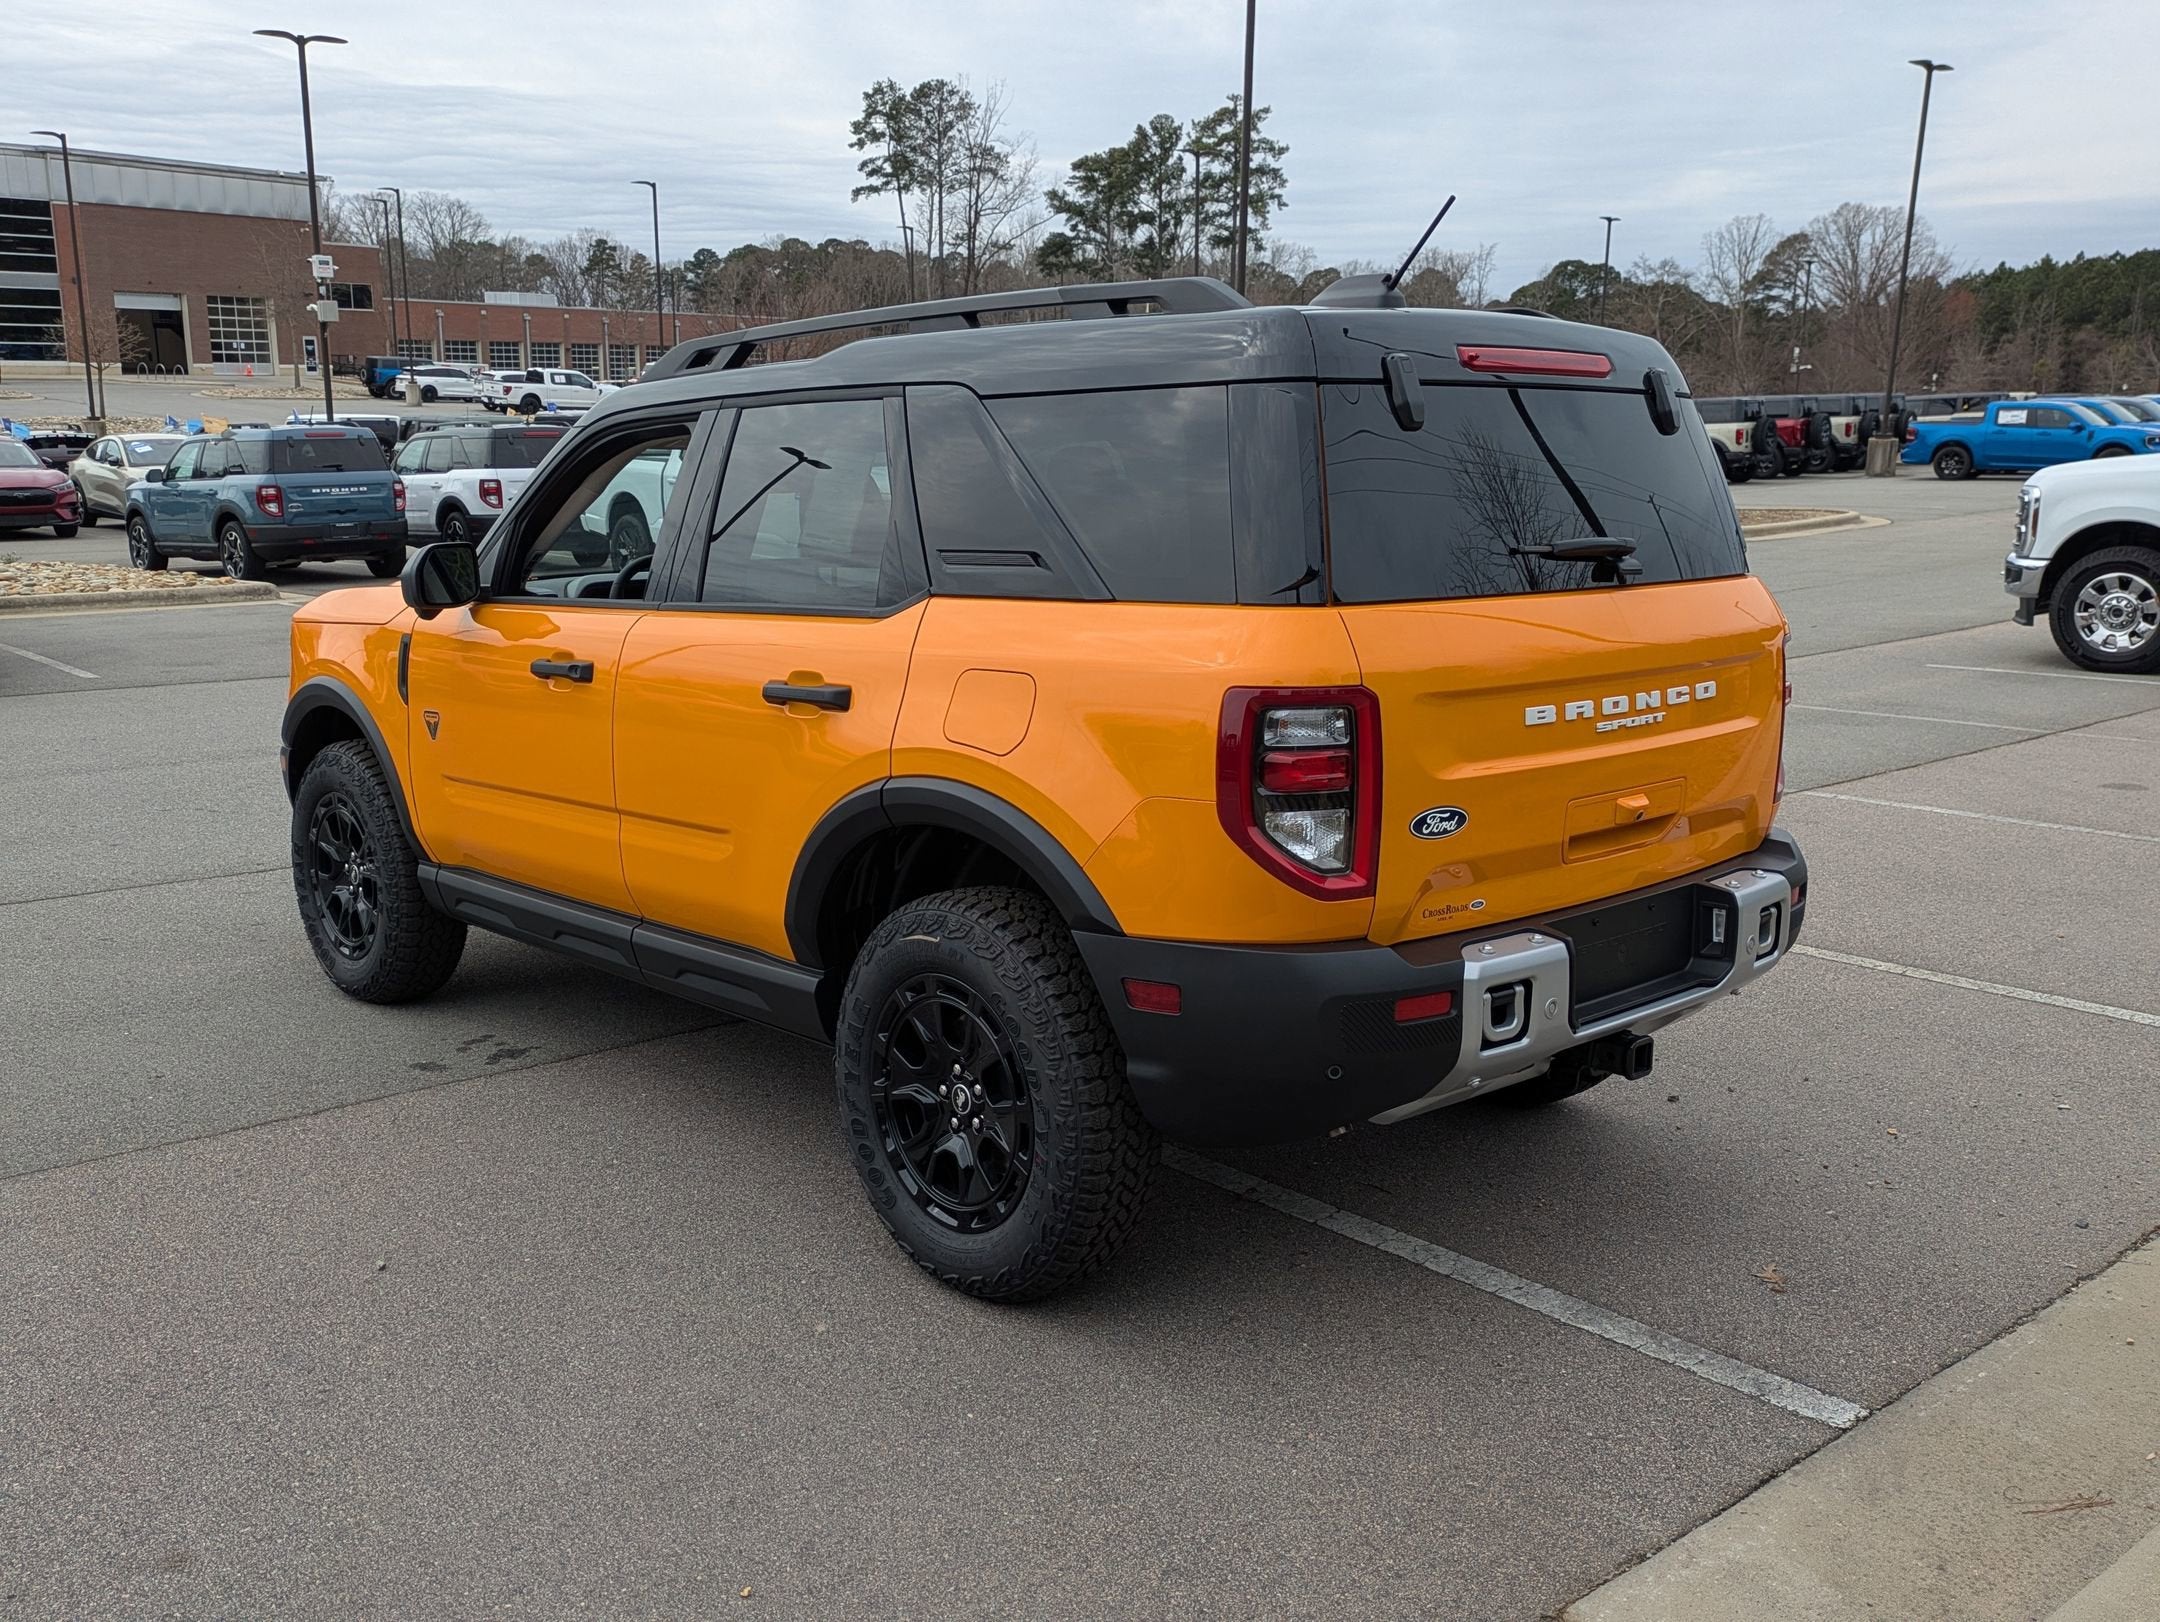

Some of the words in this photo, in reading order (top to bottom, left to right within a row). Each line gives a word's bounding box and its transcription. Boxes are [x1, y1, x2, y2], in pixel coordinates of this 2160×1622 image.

[1524, 680, 1717, 726] BRONCO
[1596, 711, 1667, 733] SPORT
[1422, 812, 1459, 834] Ford
[843, 995, 898, 1210] GOODYEAR
